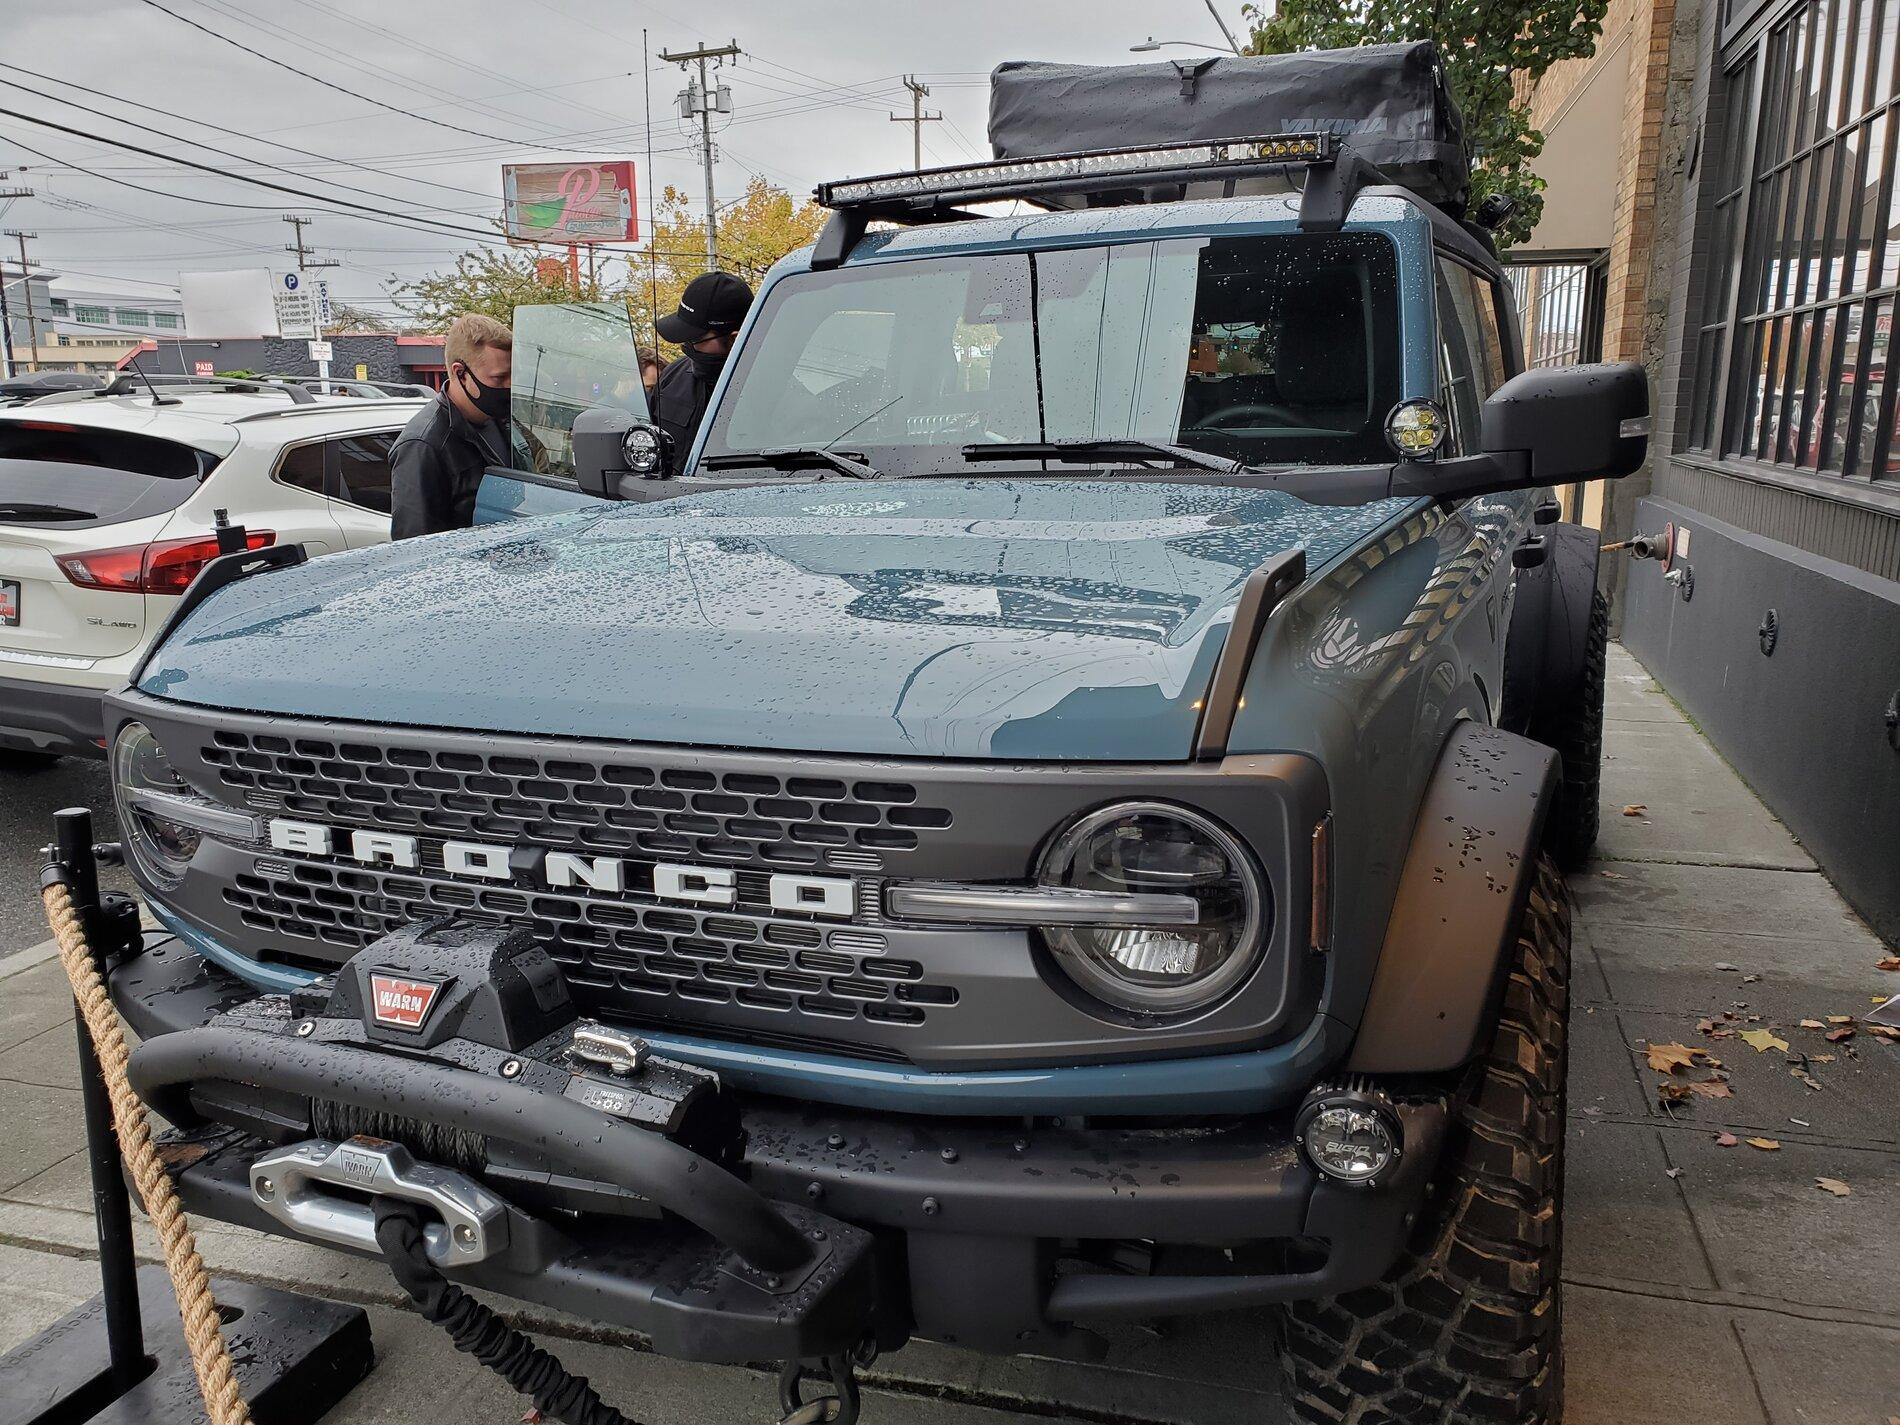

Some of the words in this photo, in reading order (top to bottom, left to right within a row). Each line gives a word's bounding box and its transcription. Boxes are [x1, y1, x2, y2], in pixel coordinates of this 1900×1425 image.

[1281, 118, 1388, 134] YAKIMA
[196, 363, 213, 371] PAID
[110, 621, 137, 629] AWD
[270, 818, 858, 916] BRONCO
[380, 991, 423, 1013] WARN
[345, 1160, 373, 1177] WARN
